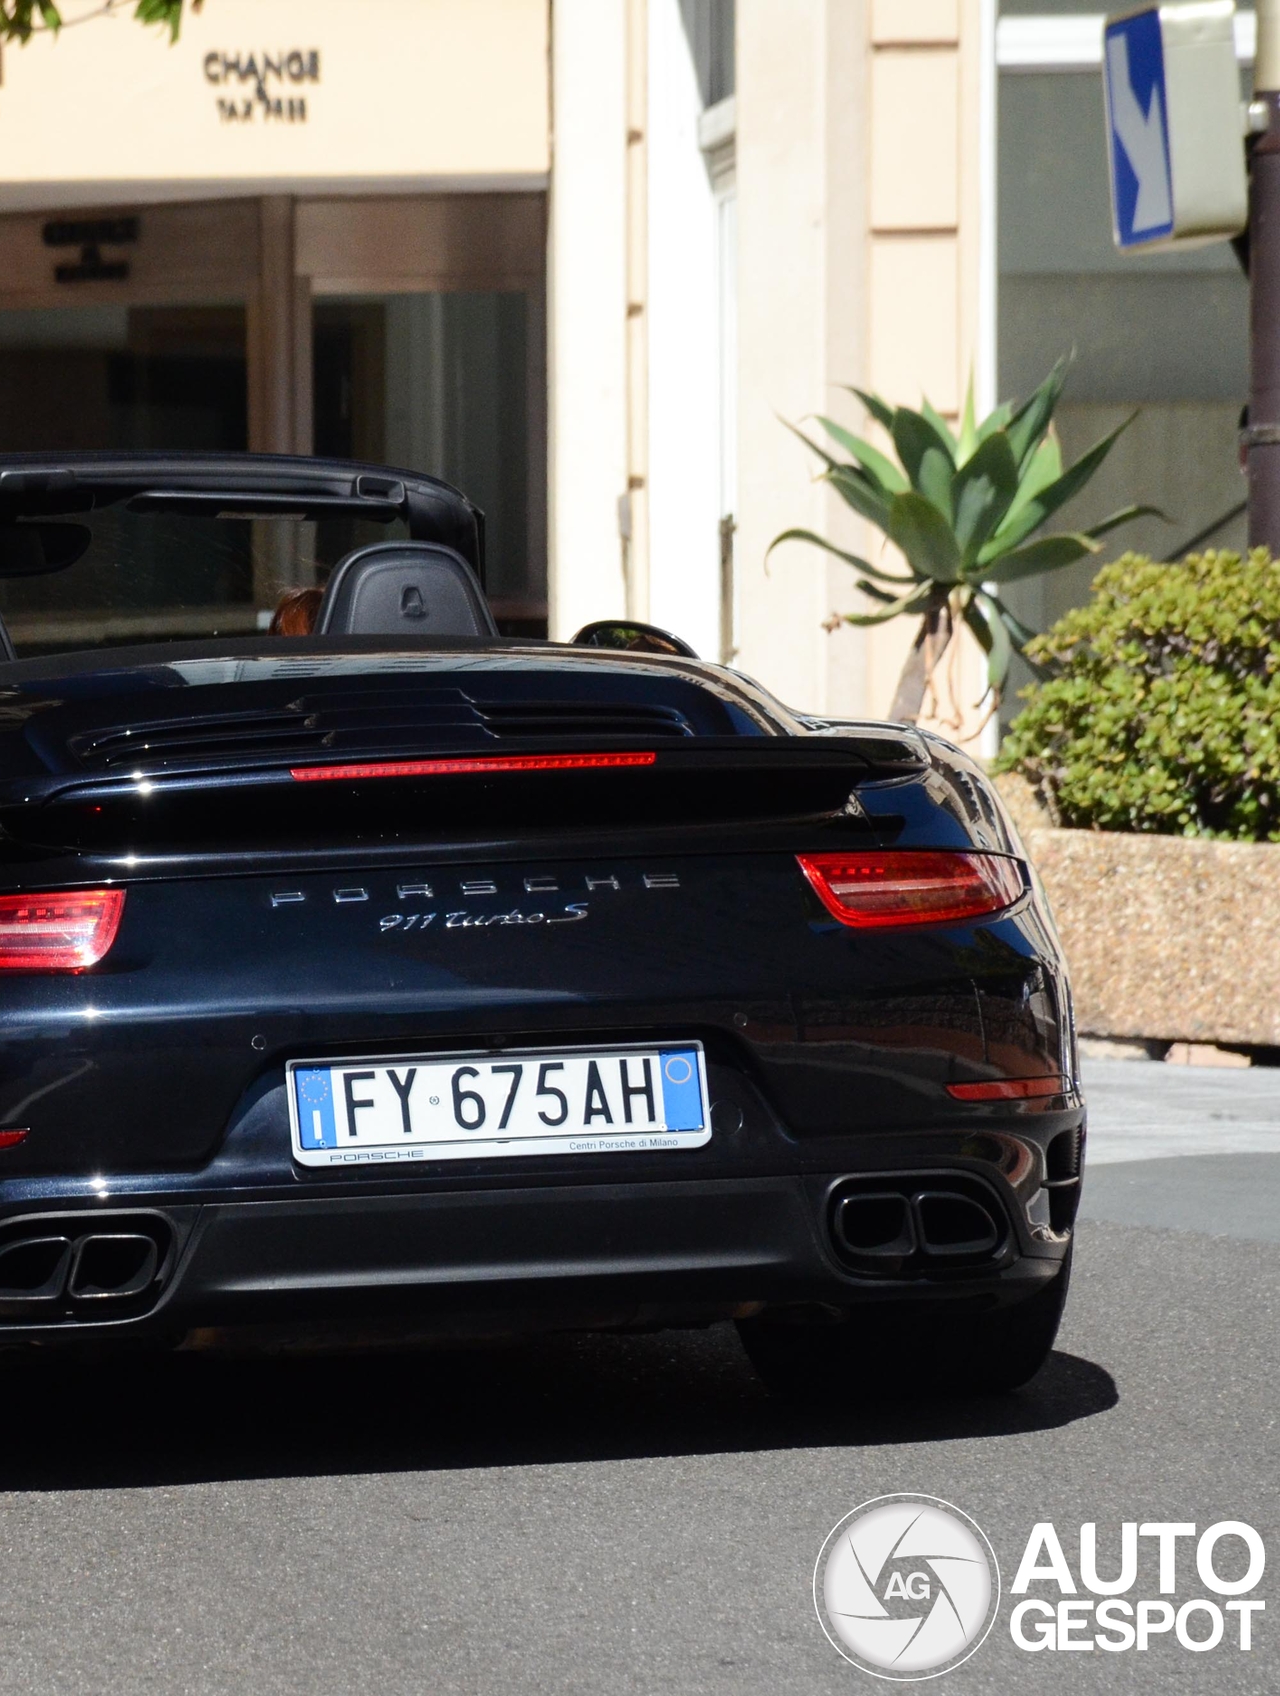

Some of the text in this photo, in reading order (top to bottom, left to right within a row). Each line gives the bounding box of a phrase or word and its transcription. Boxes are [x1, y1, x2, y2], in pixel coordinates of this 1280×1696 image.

[204, 50, 320, 84] CHANGE
[270, 873, 681, 907] PORSCHE
[378, 912, 438, 932] 911
[546, 902, 590, 924] S
[342, 1057, 657, 1137] FY 675AH
[330, 1150, 424, 1162] PORSCHE
[569, 1137, 679, 1151] Centri Porsche di Milano
